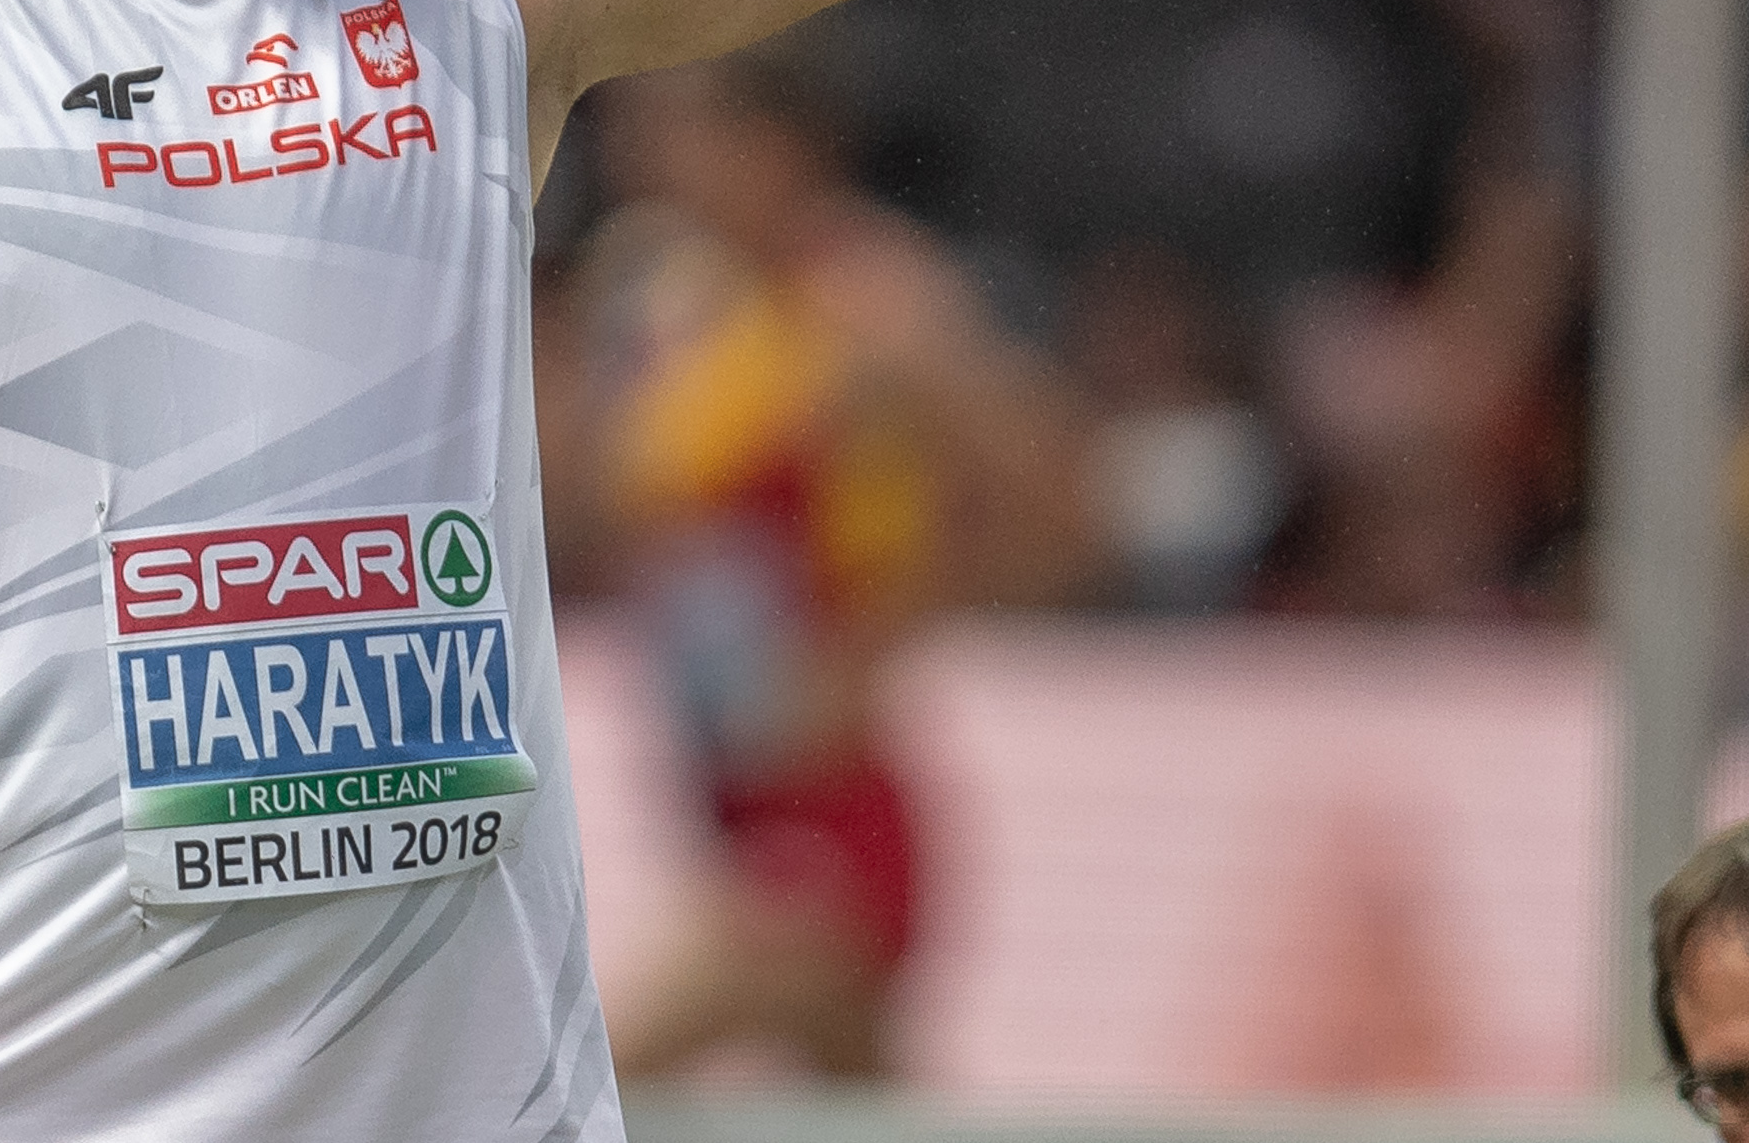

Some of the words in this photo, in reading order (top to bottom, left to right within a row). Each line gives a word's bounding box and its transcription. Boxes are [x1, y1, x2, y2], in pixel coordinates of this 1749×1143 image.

[345, 1, 396, 27] POLSKA
[215, 76, 311, 110] ORLEN
[97, 104, 437, 188] POLSKA
[122, 529, 409, 618] SPAR
[130, 627, 505, 770] HARATYK
[227, 788, 237, 817] I
[250, 781, 324, 815] RUN
[174, 824, 373, 890] BERLIN
[391, 810, 502, 871] 2018
